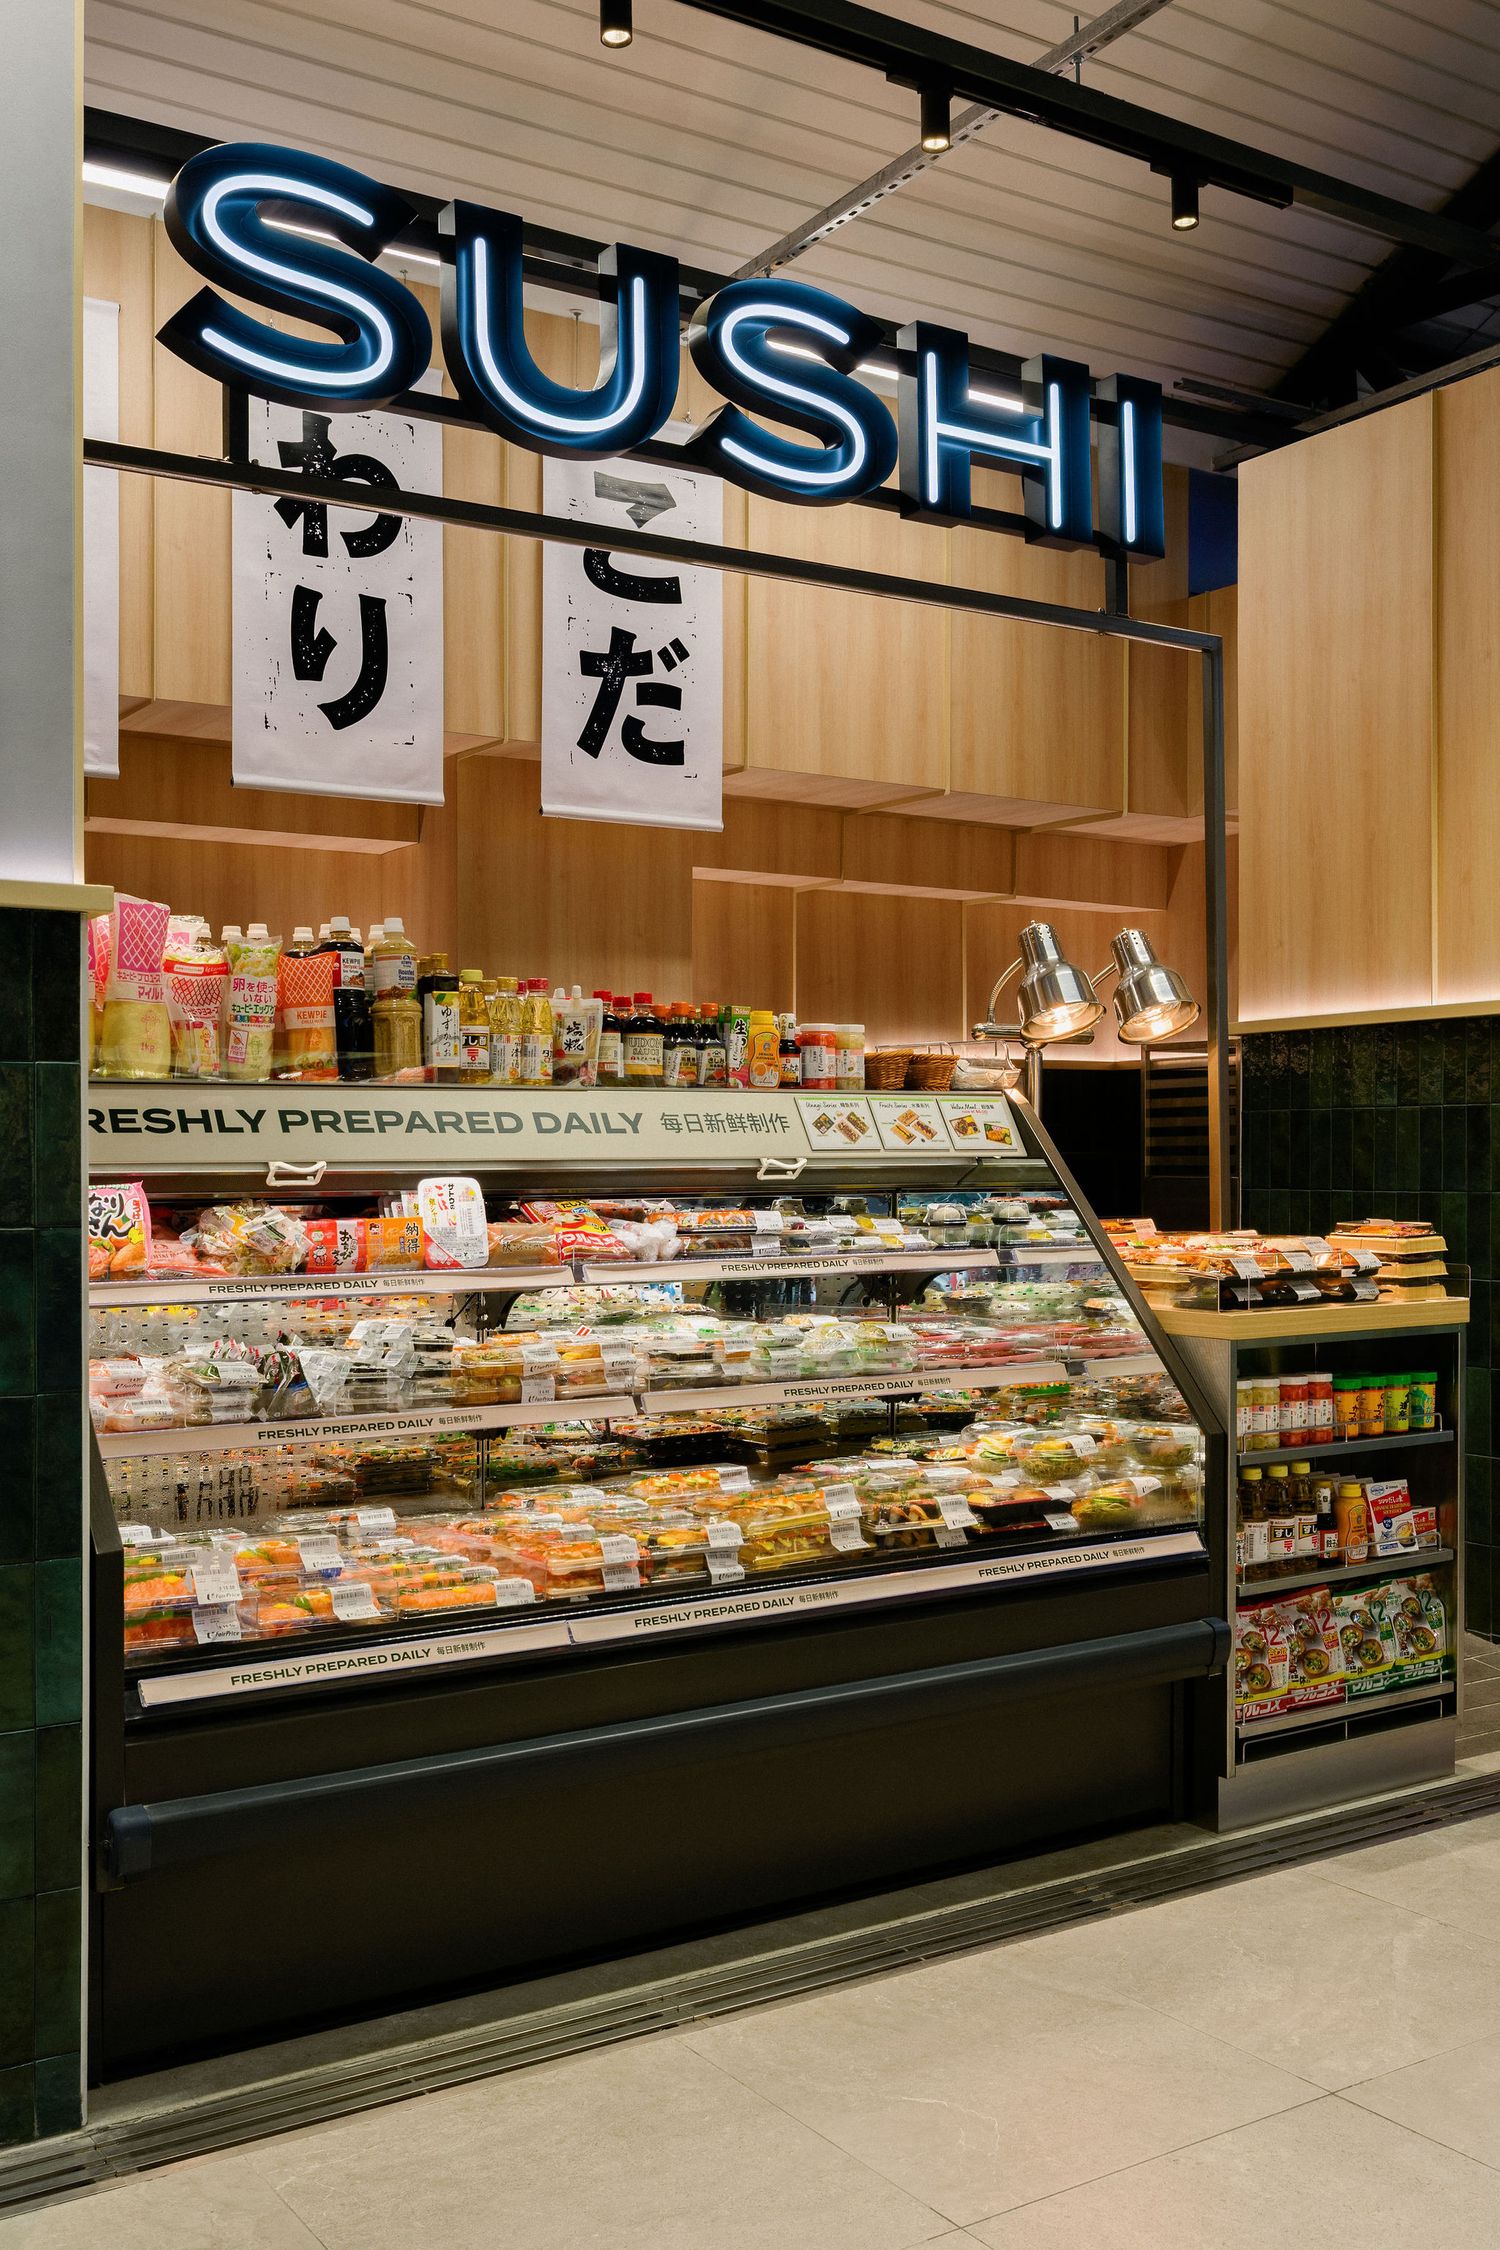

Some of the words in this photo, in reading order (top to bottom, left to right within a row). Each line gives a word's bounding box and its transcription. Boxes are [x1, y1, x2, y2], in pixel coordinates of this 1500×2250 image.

[158, 142, 1163, 558] SUSHI
[274, 411, 405, 730] わり
[578, 470, 691, 766] こだ
[243, 993, 272, 1004] いない
[296, 1010, 328, 1020] KEWPIE
[279, 1109, 525, 1134] PREPARED
[535, 1111, 642, 1134] DAILY
[660, 1112, 790, 1134] 每日新鲜制作
[405, 1222, 421, 1254] 納得
[721, 1264, 765, 1272] FRESHLY
[767, 1261, 820, 1271] PREPARED
[822, 1259, 849, 1268] DAILY
[208, 1284, 268, 1294] FRESHLY
[270, 1282, 340, 1292] PREPARED
[343, 1280, 378, 1290] DAILY
[784, 1386, 830, 1397] FRESHLY
[831, 1383, 885, 1394] PREPARED
[886, 1380, 914, 1389] DAILY
[258, 1427, 319, 1440] FRESHLY
[322, 1421, 395, 1436] PREPARED
[397, 1418, 433, 1430] DAILY
[978, 1563, 1025, 1578] FRESHLY
[1027, 1555, 1082, 1570] PREPARED
[1083, 1551, 1110, 1562] DAILY
[634, 1611, 692, 1629] FRESHLY
[694, 1601, 760, 1618] PREPARED
[763, 1596, 795, 1609] DAILY
[214, 1630, 241, 1639] FairPrice
[230, 1666, 302, 1686] FRESHLY
[305, 1654, 388, 1675] PREPARED
[391, 1647, 431, 1663] DAILY
[436, 1641, 487, 1656] 每日新鲜制作
